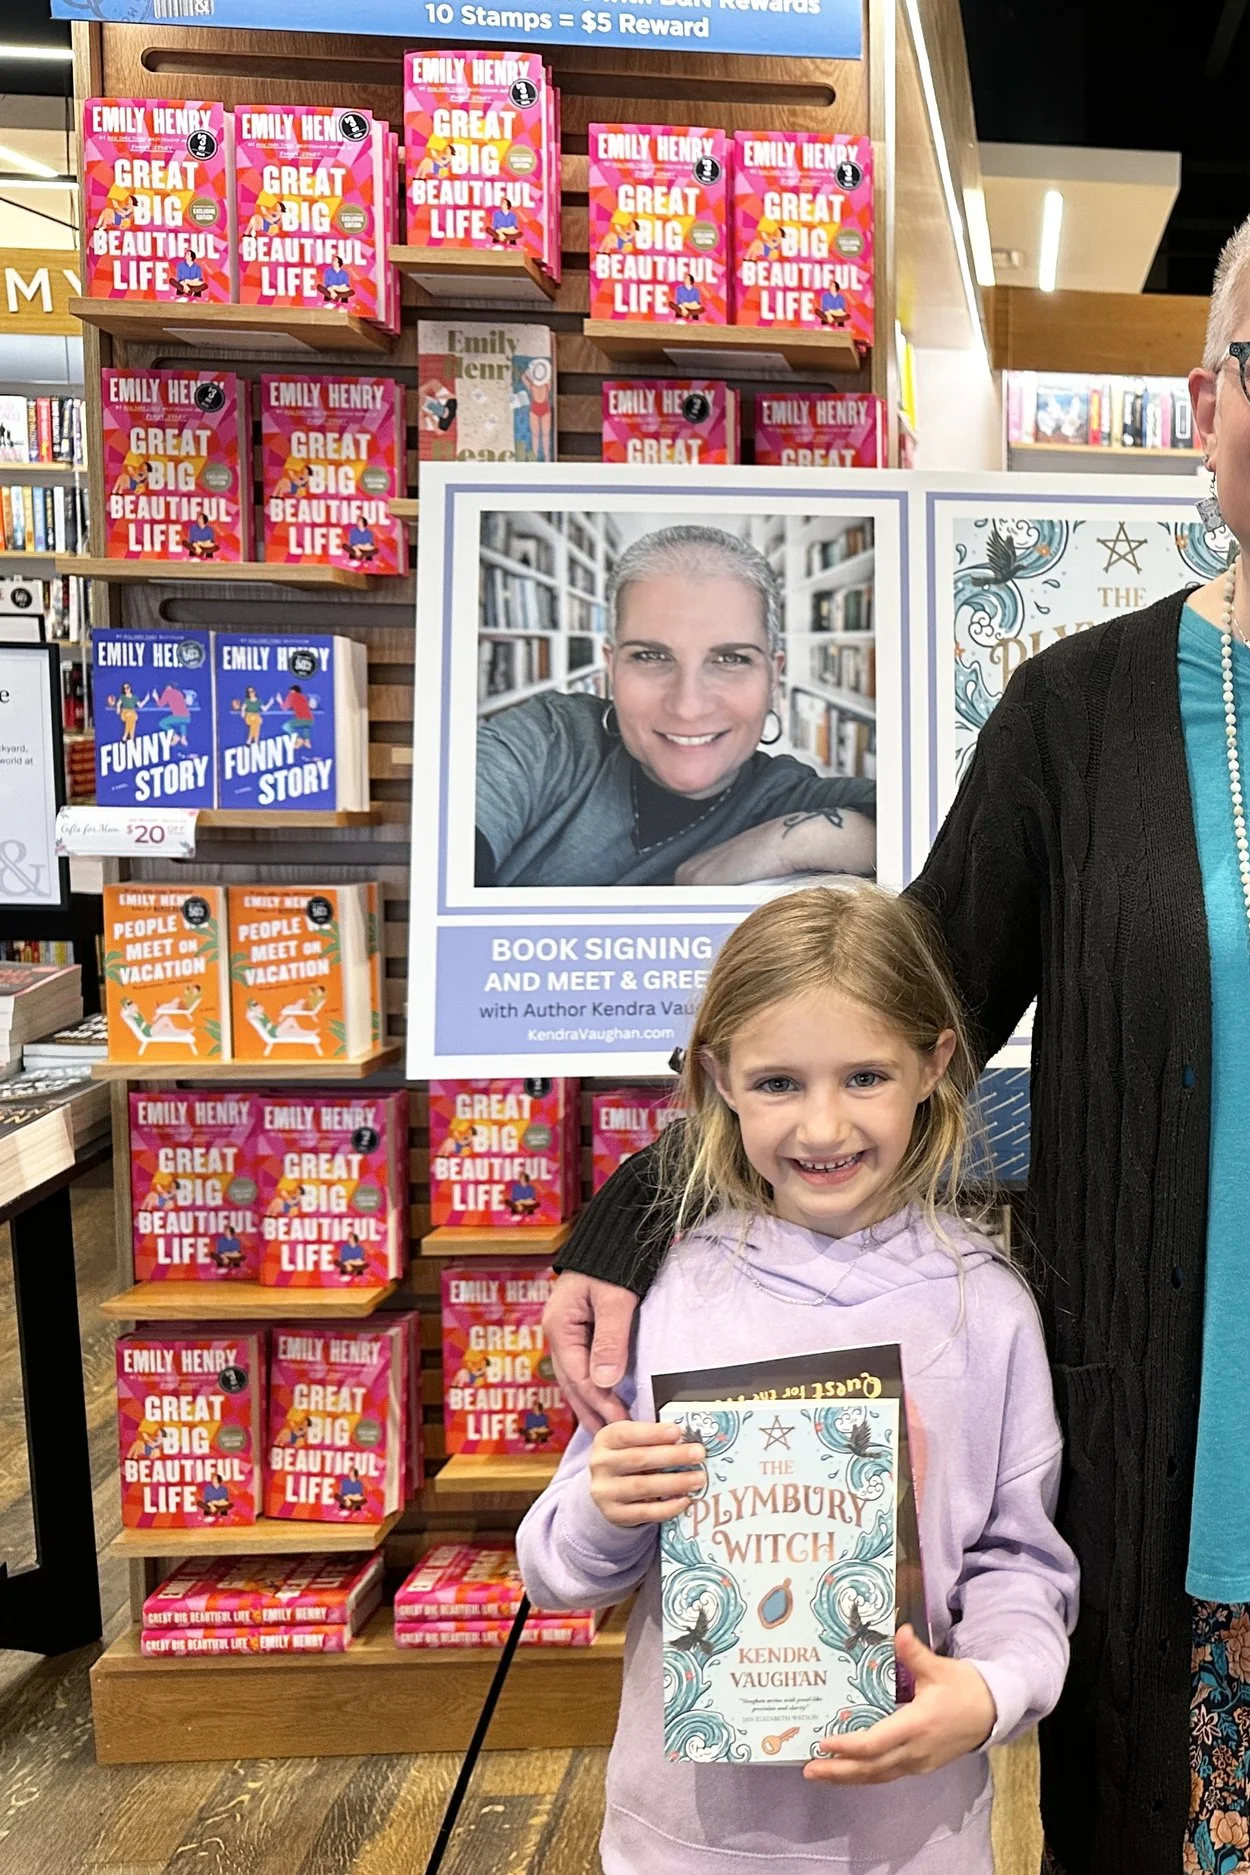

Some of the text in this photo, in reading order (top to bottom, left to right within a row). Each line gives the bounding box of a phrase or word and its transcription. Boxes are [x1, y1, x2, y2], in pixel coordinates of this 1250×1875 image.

[426, 4, 709, 38] 10 Stamps = $5 Reward
[412, 57, 530, 86] EMILY HENRY
[93, 106, 211, 134] EMILY HENRY
[242, 113, 344, 142] EMILY HEN
[433, 109, 515, 139] GREAT
[452, 144, 499, 176] BIG
[598, 134, 714, 162] EMILY HENRY
[743, 140, 858, 170] EMILY HENRY
[114, 158, 198, 191] GREAT
[263, 165, 346, 197] GREAT
[412, 180, 535, 208] BEAUTIFUL
[617, 185, 699, 216] GREAT
[763, 191, 846, 223] GREAT
[134, 195, 182, 227] BIG
[282, 200, 330, 232] BIG
[430, 209, 486, 239] LIFE
[94, 229, 220, 260] BEAUTIFUL
[637, 219, 684, 251] BIG
[782, 226, 829, 260] BIG
[243, 235, 367, 266] BEAUTIFUL
[113, 260, 169, 291] LIFE
[261, 266, 317, 297] LIFE
[595, 254, 718, 285] BEAUTIFUL
[741, 260, 863, 290] BEAUTIFUL
[614, 284, 669, 315] LIFE
[760, 291, 815, 322] LIFE
[448, 330, 519, 361] Emily
[110, 377, 160, 404] EMILY
[270, 382, 385, 410] EMILY HENRY
[609, 389, 655, 415] EMILY
[763, 400, 868, 425] EMILY HENRY
[130, 427, 211, 456] GREAT
[290, 432, 371, 460] GREAT
[626, 438, 701, 465] GREAT
[780, 448, 855, 467] GREAT
[148, 461, 195, 492] BIG
[308, 465, 356, 495] BIG
[110, 494, 232, 523] BEAUTIFUL
[269, 498, 391, 526] BEAUTIFUL
[128, 524, 183, 553] LIFE
[288, 527, 342, 556] LIFE
[1097, 587, 1148, 608] THE
[99, 643, 145, 667] EMILY
[223, 646, 269, 671] EMILY
[24, 758, 34, 766] at
[100, 729, 175, 776] FUNNY
[224, 733, 299, 780] FUNNY
[135, 756, 209, 801] STORY
[258, 759, 333, 805] STORY
[127, 825, 165, 844] $20
[119, 893, 154, 906] EMILY
[243, 896, 277, 908] EMILY
[113, 916, 177, 940] PEOPLE
[238, 918, 301, 942] PEOPLE
[126, 939, 198, 961] MEET ON
[250, 941, 321, 963] MEET ON
[492, 936, 712, 962] BOOK SIGNING
[119, 958, 206, 986] VACATION
[244, 959, 330, 987] VACATION
[484, 970, 708, 992] AND MEET & GREE
[480, 1003, 518, 1019] with
[524, 1002, 587, 1018] Author
[592, 1001, 655, 1016] Kendra
[528, 1028, 674, 1043] KendraVaughan.com
[138, 1102, 250, 1125] EMILY HENRY
[455, 1093, 532, 1120] GREAT
[600, 1108, 649, 1130] EMILY
[472, 1125, 519, 1153] BIG
[158, 1147, 237, 1174] GREAT
[435, 1157, 552, 1180] BEAUTIFUL
[176, 1178, 223, 1206] BIG
[452, 1184, 506, 1212] LIFE
[138, 1211, 257, 1235] BEAUTIFUL
[157, 1238, 210, 1264] LIFE
[123, 1349, 237, 1374] EMILY HENRY
[782, 1385, 806, 1399] for
[812, 1372, 882, 1399] Quest
[144, 1396, 225, 1422] GREAT
[162, 1427, 210, 1455] BIG
[125, 1459, 246, 1484] BEAUTIFUL
[760, 1460, 794, 1475] THE
[143, 1486, 198, 1514] LIFE
[685, 1483, 868, 1538] PLYMBURY
[712, 1531, 836, 1564] WITCH
[262, 1608, 293, 1621] EMILY
[295, 1606, 328, 1621] HENRY
[738, 1646, 822, 1664] KENDRA
[730, 1670, 828, 1688] VAUGHAN
